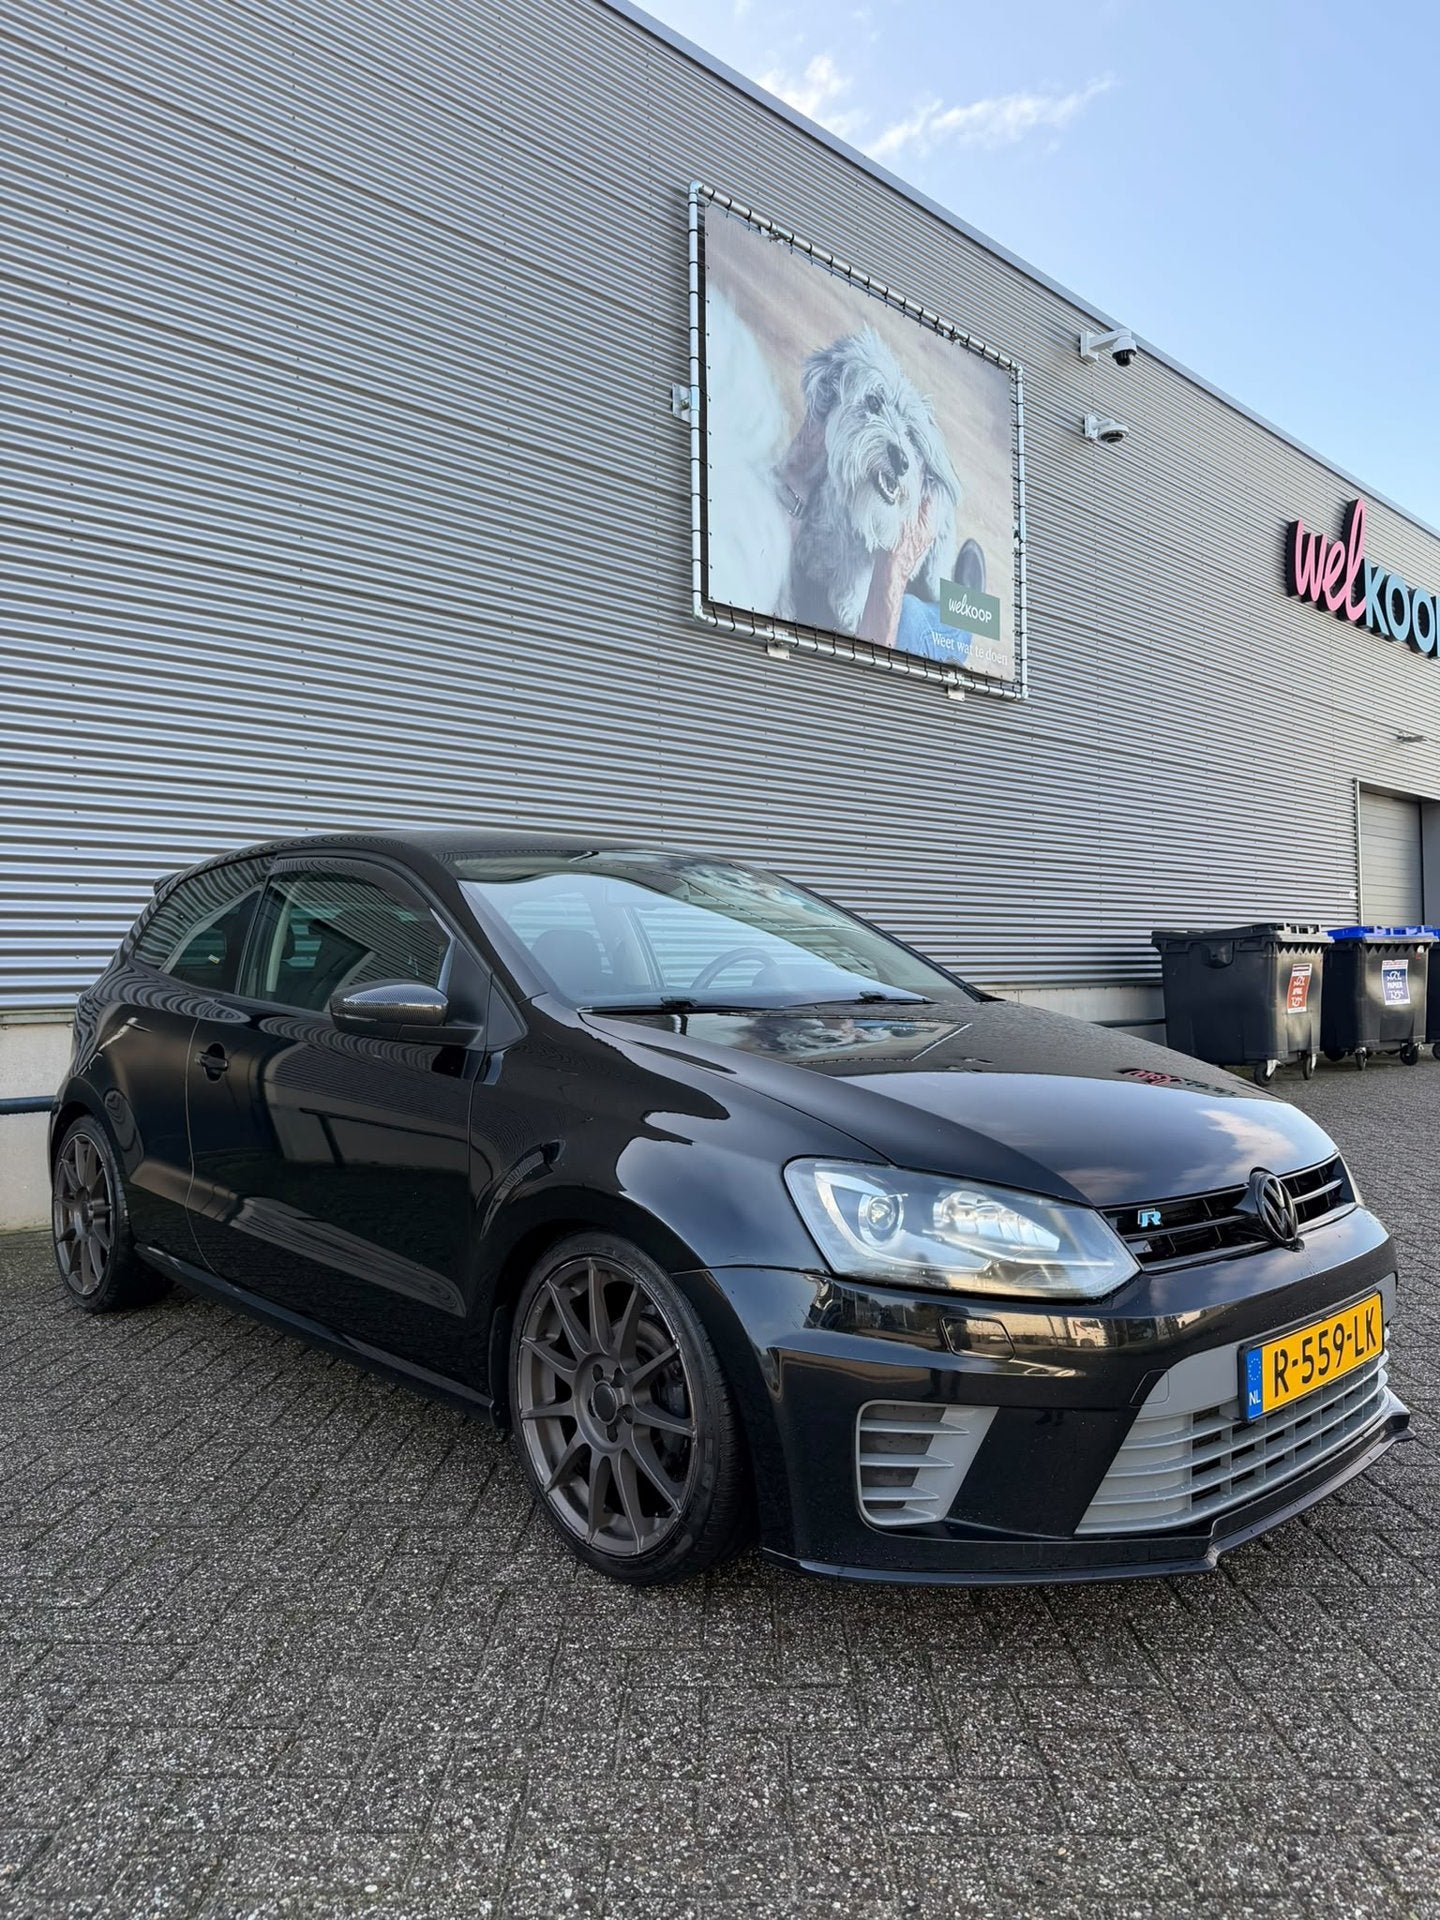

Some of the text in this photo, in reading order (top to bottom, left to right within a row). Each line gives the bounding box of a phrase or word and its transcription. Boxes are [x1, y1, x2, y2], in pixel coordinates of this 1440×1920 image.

[1293, 497, 1440, 658] welKOO
[931, 631, 1008, 666] Weet wat te doen
[1137, 1208, 1161, 1227] R
[1274, 1306, 1377, 1398] R-559-LK
[1249, 1390, 1261, 1406] NL
